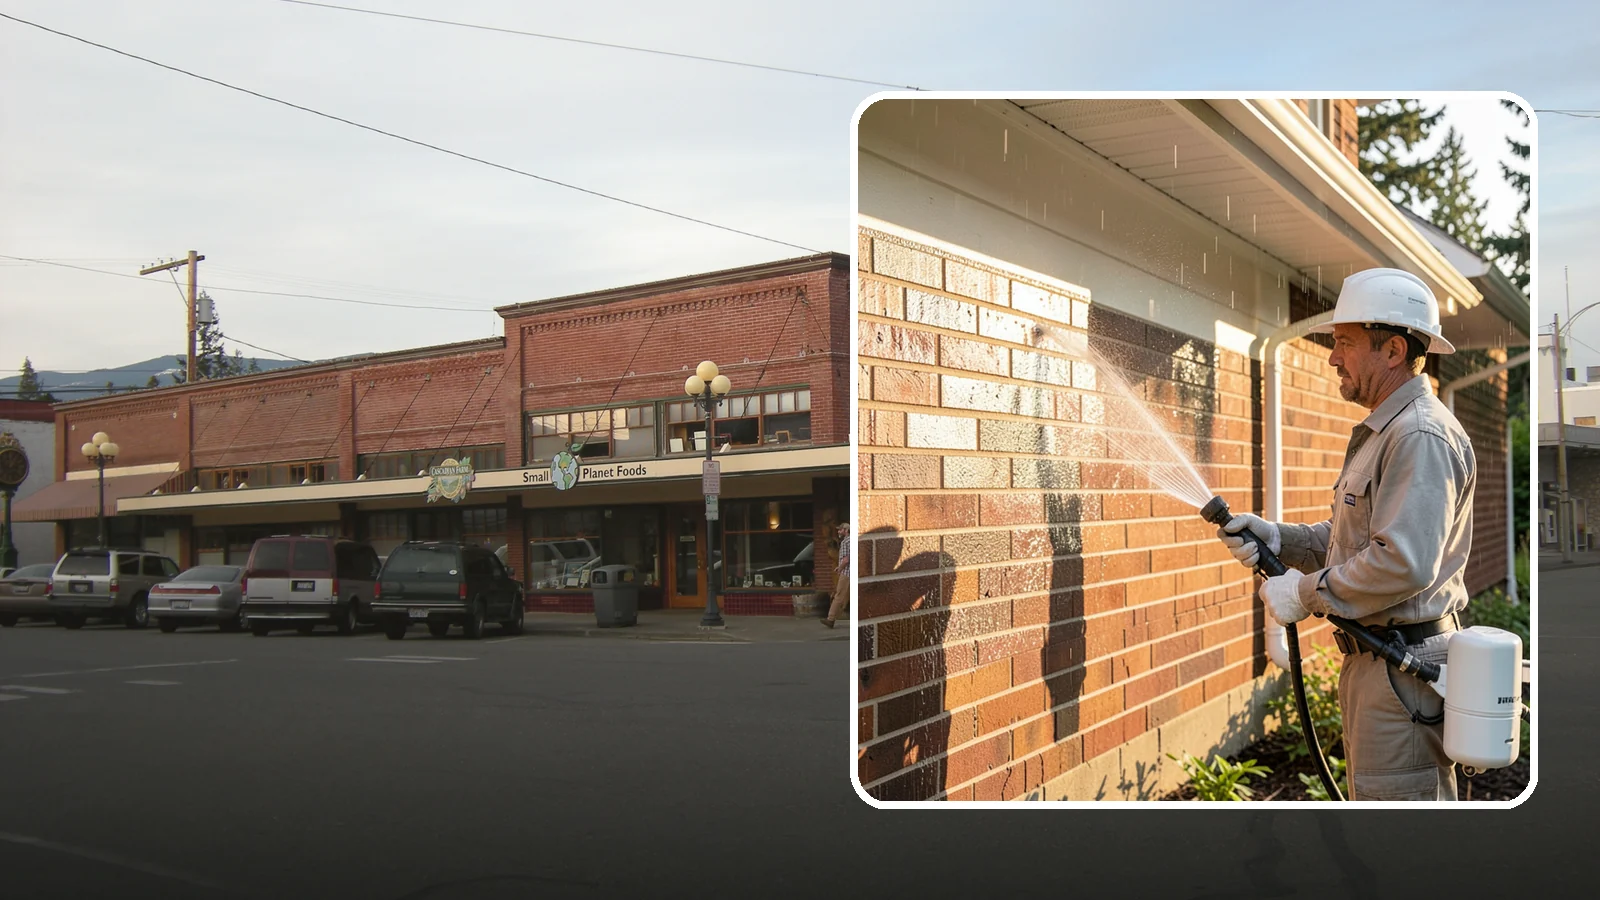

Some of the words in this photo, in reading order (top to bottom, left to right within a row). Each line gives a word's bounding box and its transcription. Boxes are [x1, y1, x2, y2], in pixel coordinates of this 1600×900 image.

[523, 472, 548, 482] Small
[582, 468, 614, 479] Planet
[617, 465, 646, 476] Foods
